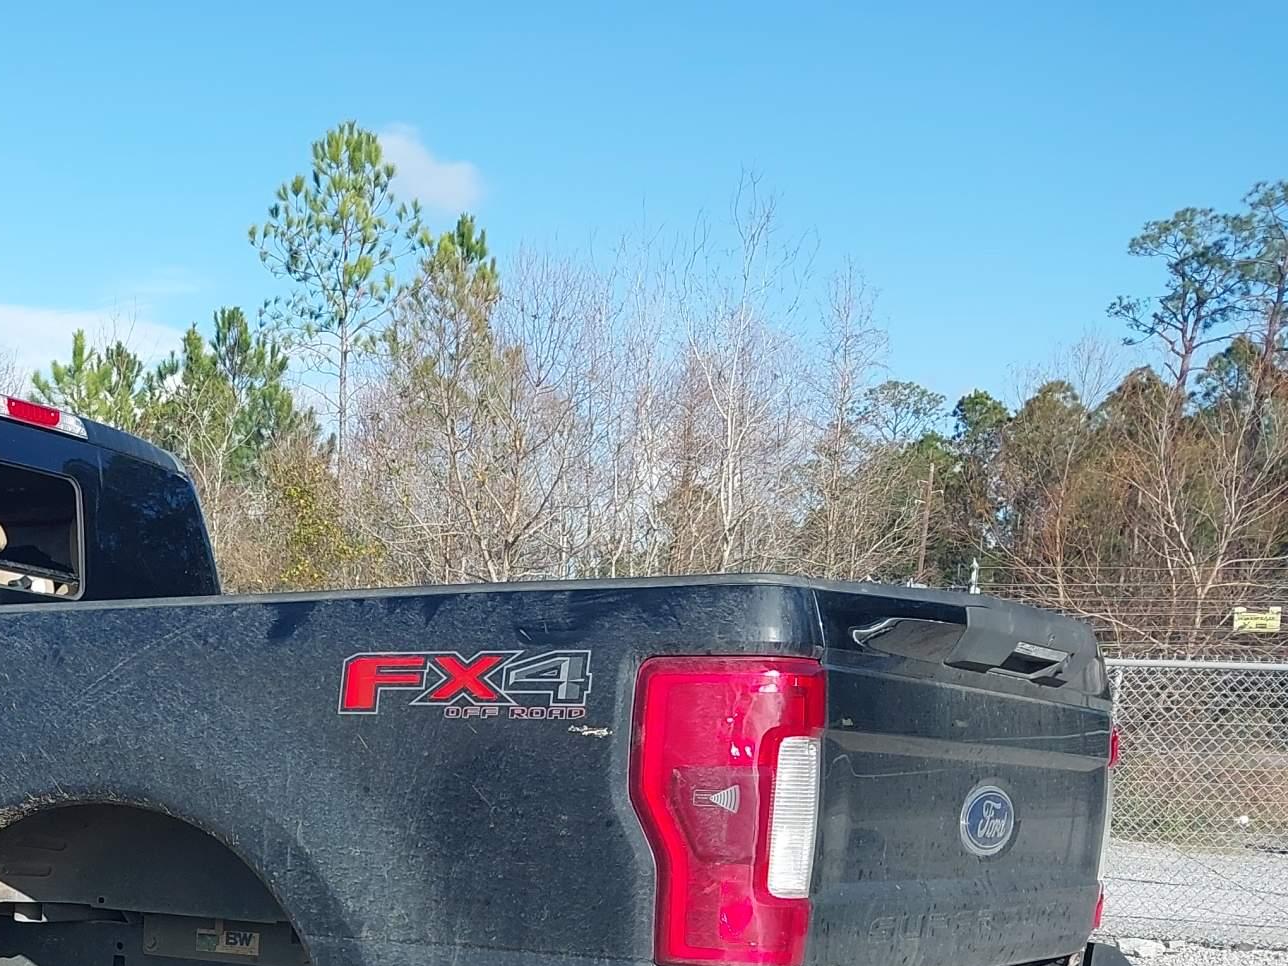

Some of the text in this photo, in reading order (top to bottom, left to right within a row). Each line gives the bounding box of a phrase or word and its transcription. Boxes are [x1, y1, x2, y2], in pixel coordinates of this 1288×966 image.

[338, 650, 593, 714] FX4
[444, 706, 586, 720] OFF ROAD
[977, 800, 1008, 838] Ford
[224, 931, 254, 947] BW
